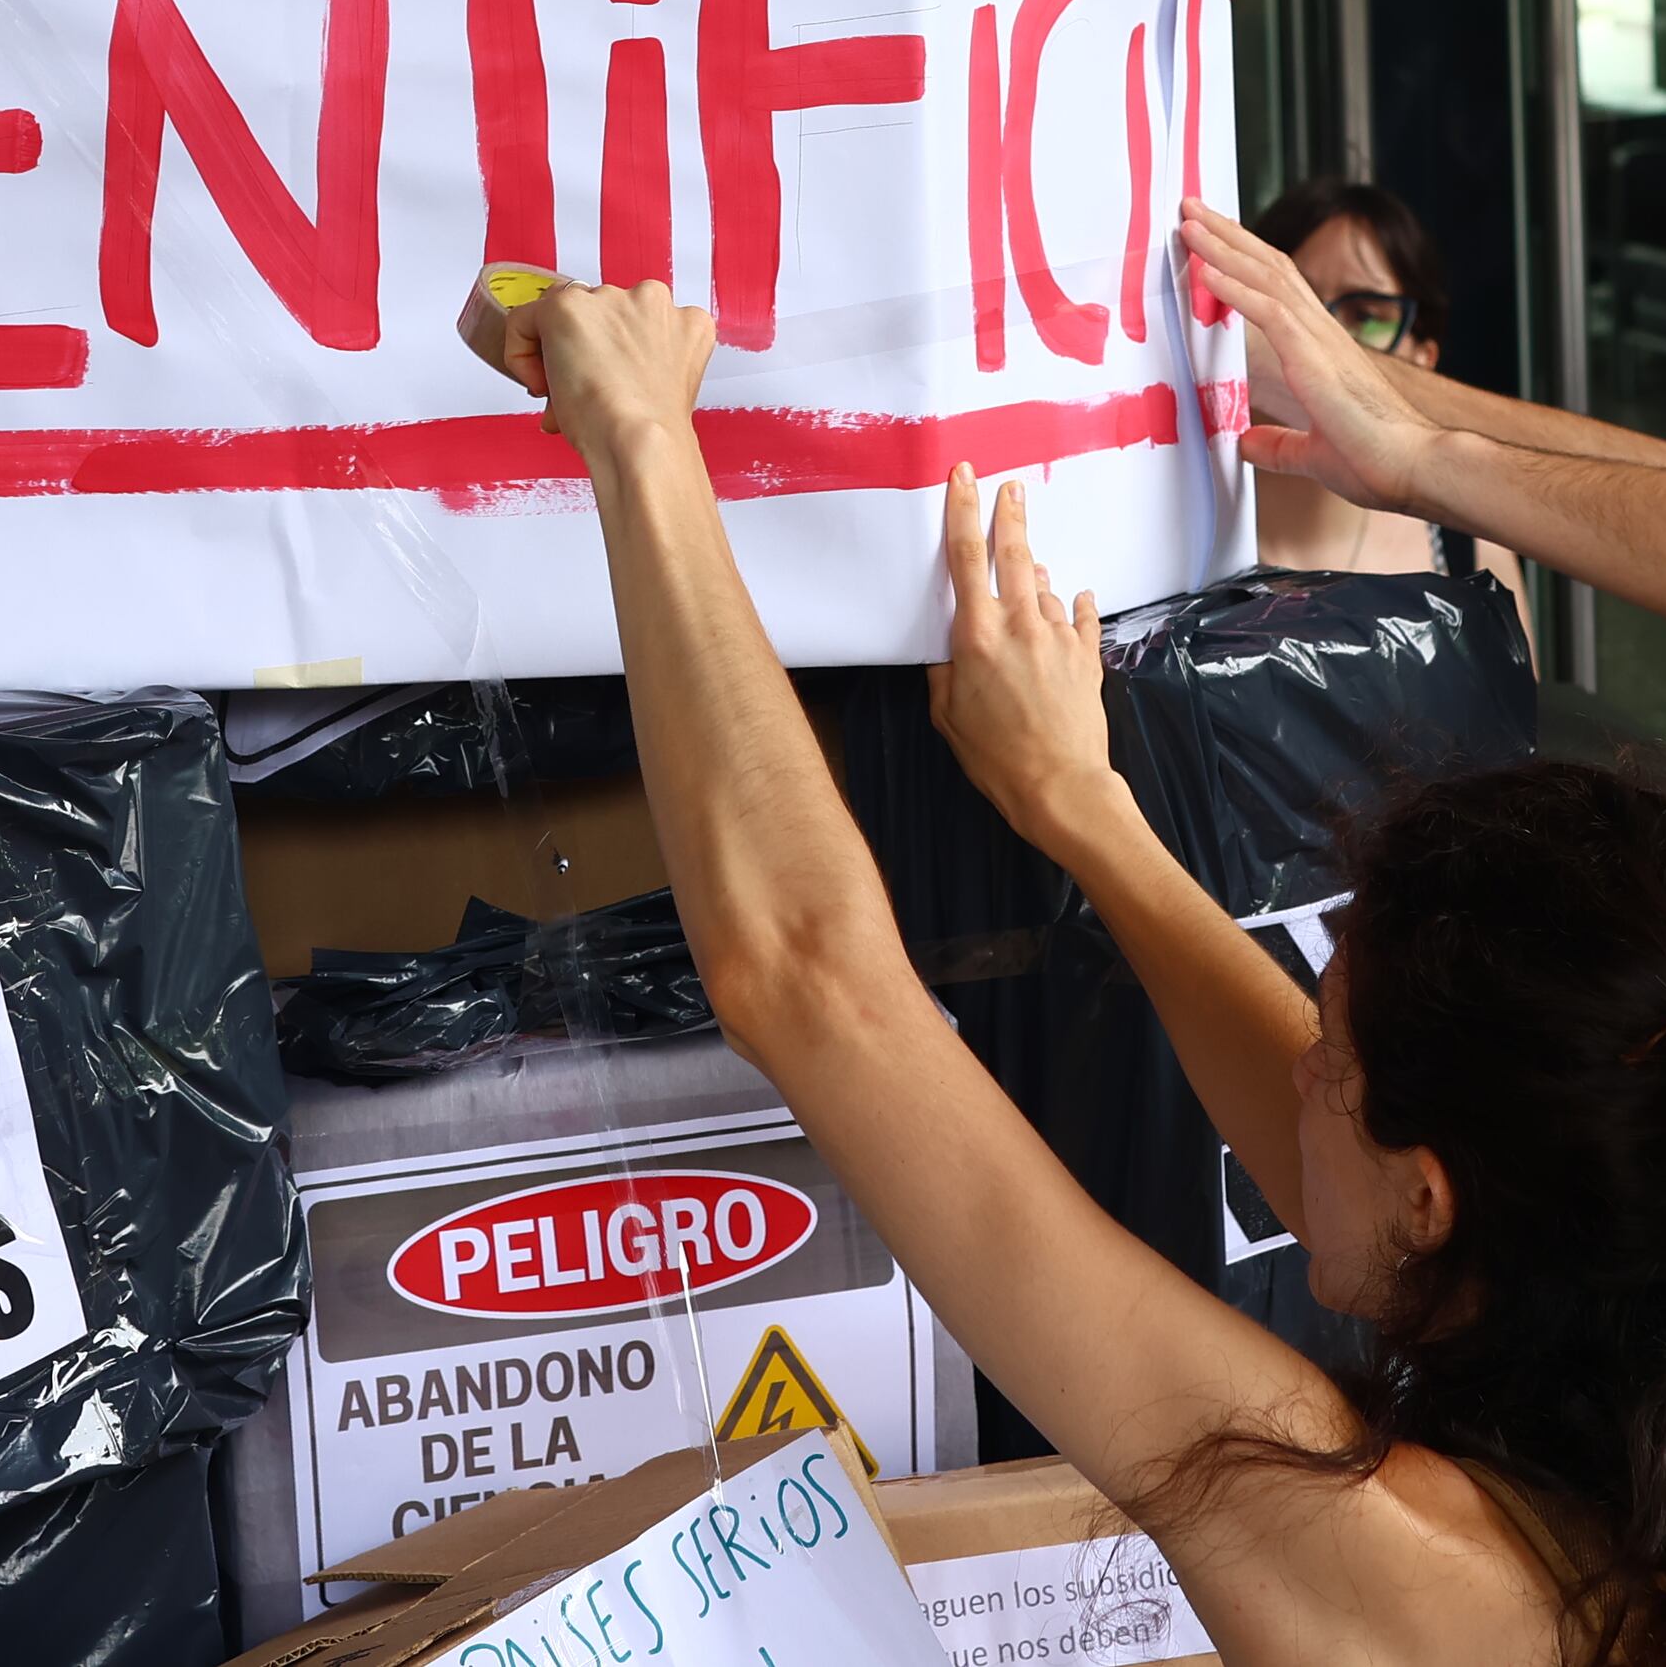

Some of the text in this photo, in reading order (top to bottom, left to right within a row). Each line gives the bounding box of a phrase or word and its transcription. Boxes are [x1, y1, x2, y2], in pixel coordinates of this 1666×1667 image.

[438, 1188, 767, 1302] PELIGRO
[337, 1340, 656, 1432] ABANDONO
[421, 1416, 582, 1483] DE LA
[1013, 1580, 1055, 1609] los
[998, 1637, 1050, 1664] nos
